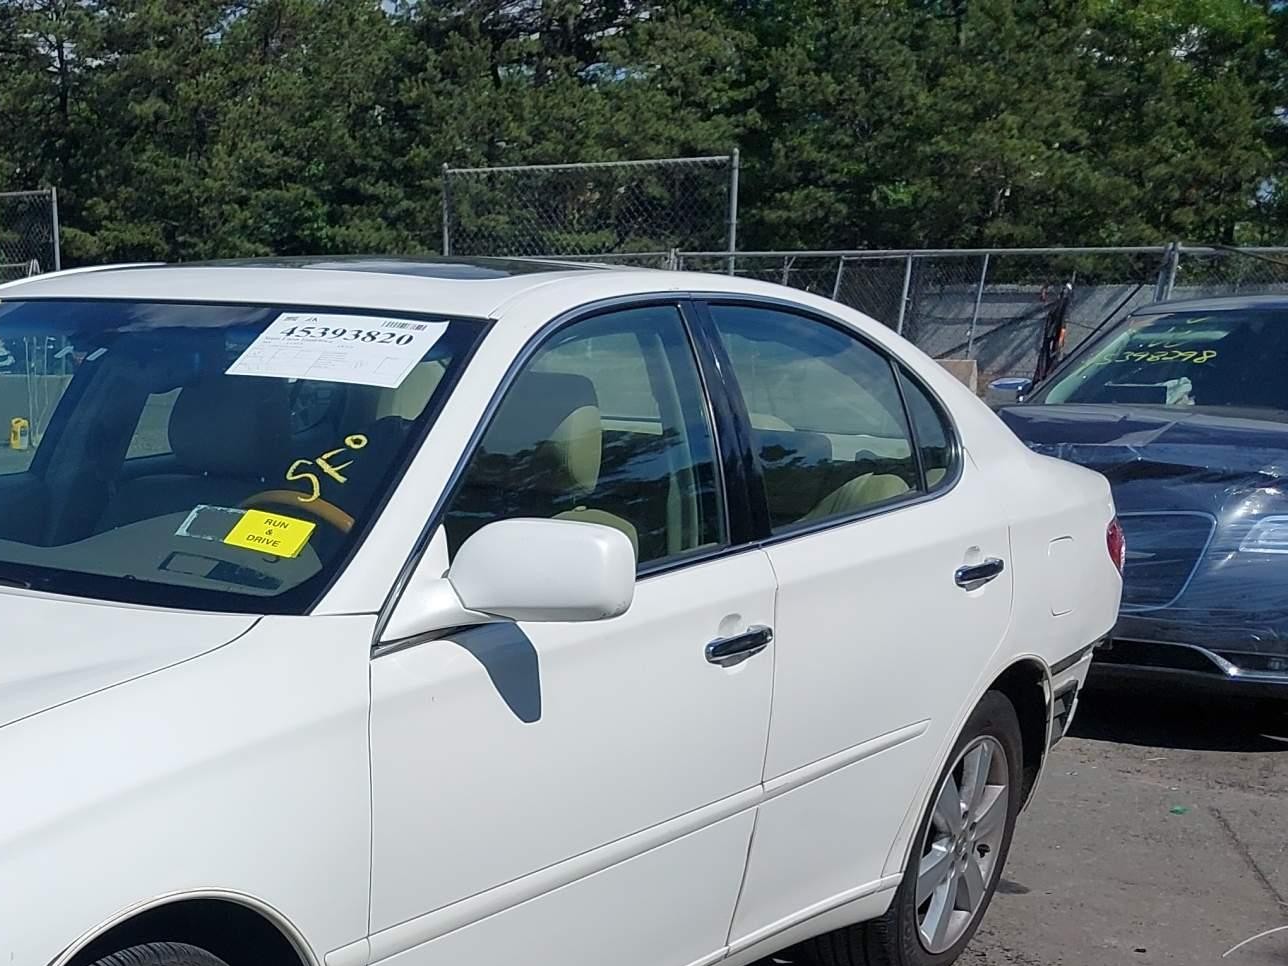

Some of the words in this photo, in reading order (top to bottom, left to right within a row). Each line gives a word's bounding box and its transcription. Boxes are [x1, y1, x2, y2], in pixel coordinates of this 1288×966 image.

[280, 325, 414, 346] 45393820
[263, 518, 290, 529] RUN
[246, 534, 281, 548] DRIVE
